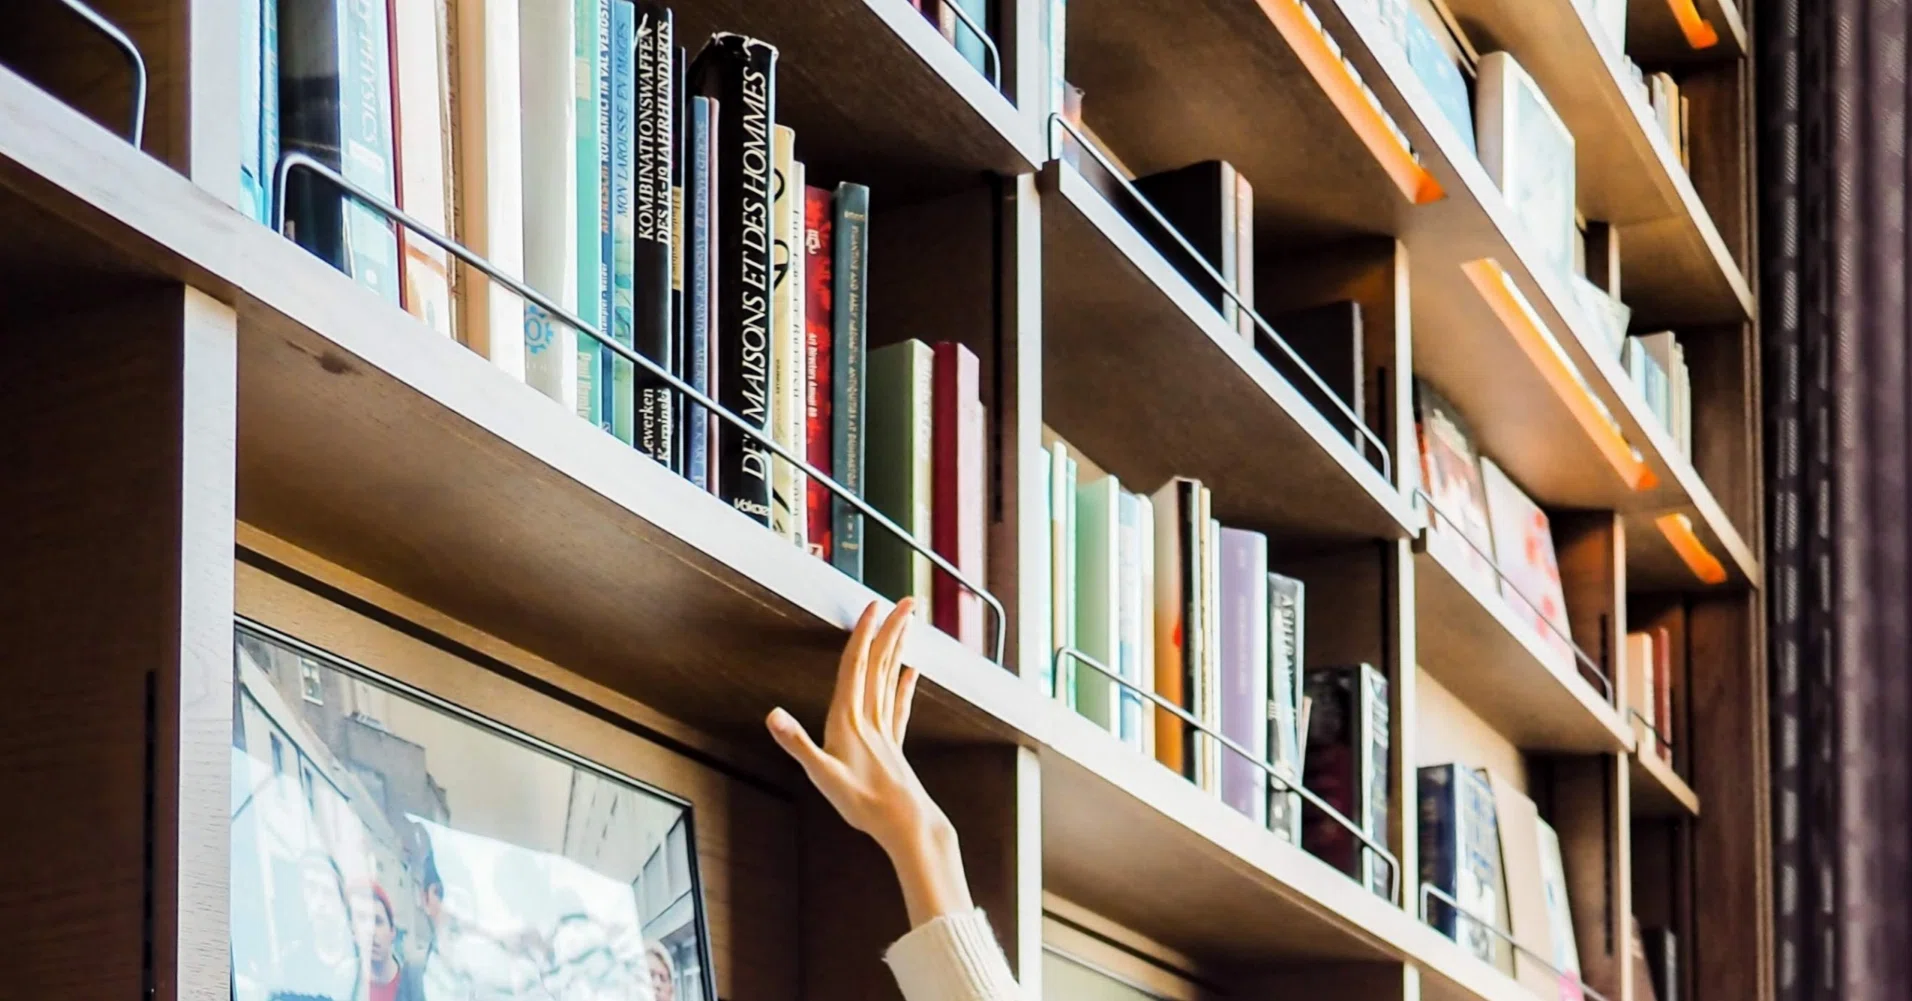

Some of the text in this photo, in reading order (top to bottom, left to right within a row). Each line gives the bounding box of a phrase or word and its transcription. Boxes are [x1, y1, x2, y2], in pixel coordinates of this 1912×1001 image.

[615, 21, 628, 218] MON LAROUSSE EN IMAGES
[638, 27, 654, 240] KOMBINATIONSWAFFEN
[656, 21, 669, 164] JAHRHUNDERTS
[656, 209, 669, 245] DES
[742, 66, 767, 481] DE MAISONS ET DES HOMMES
